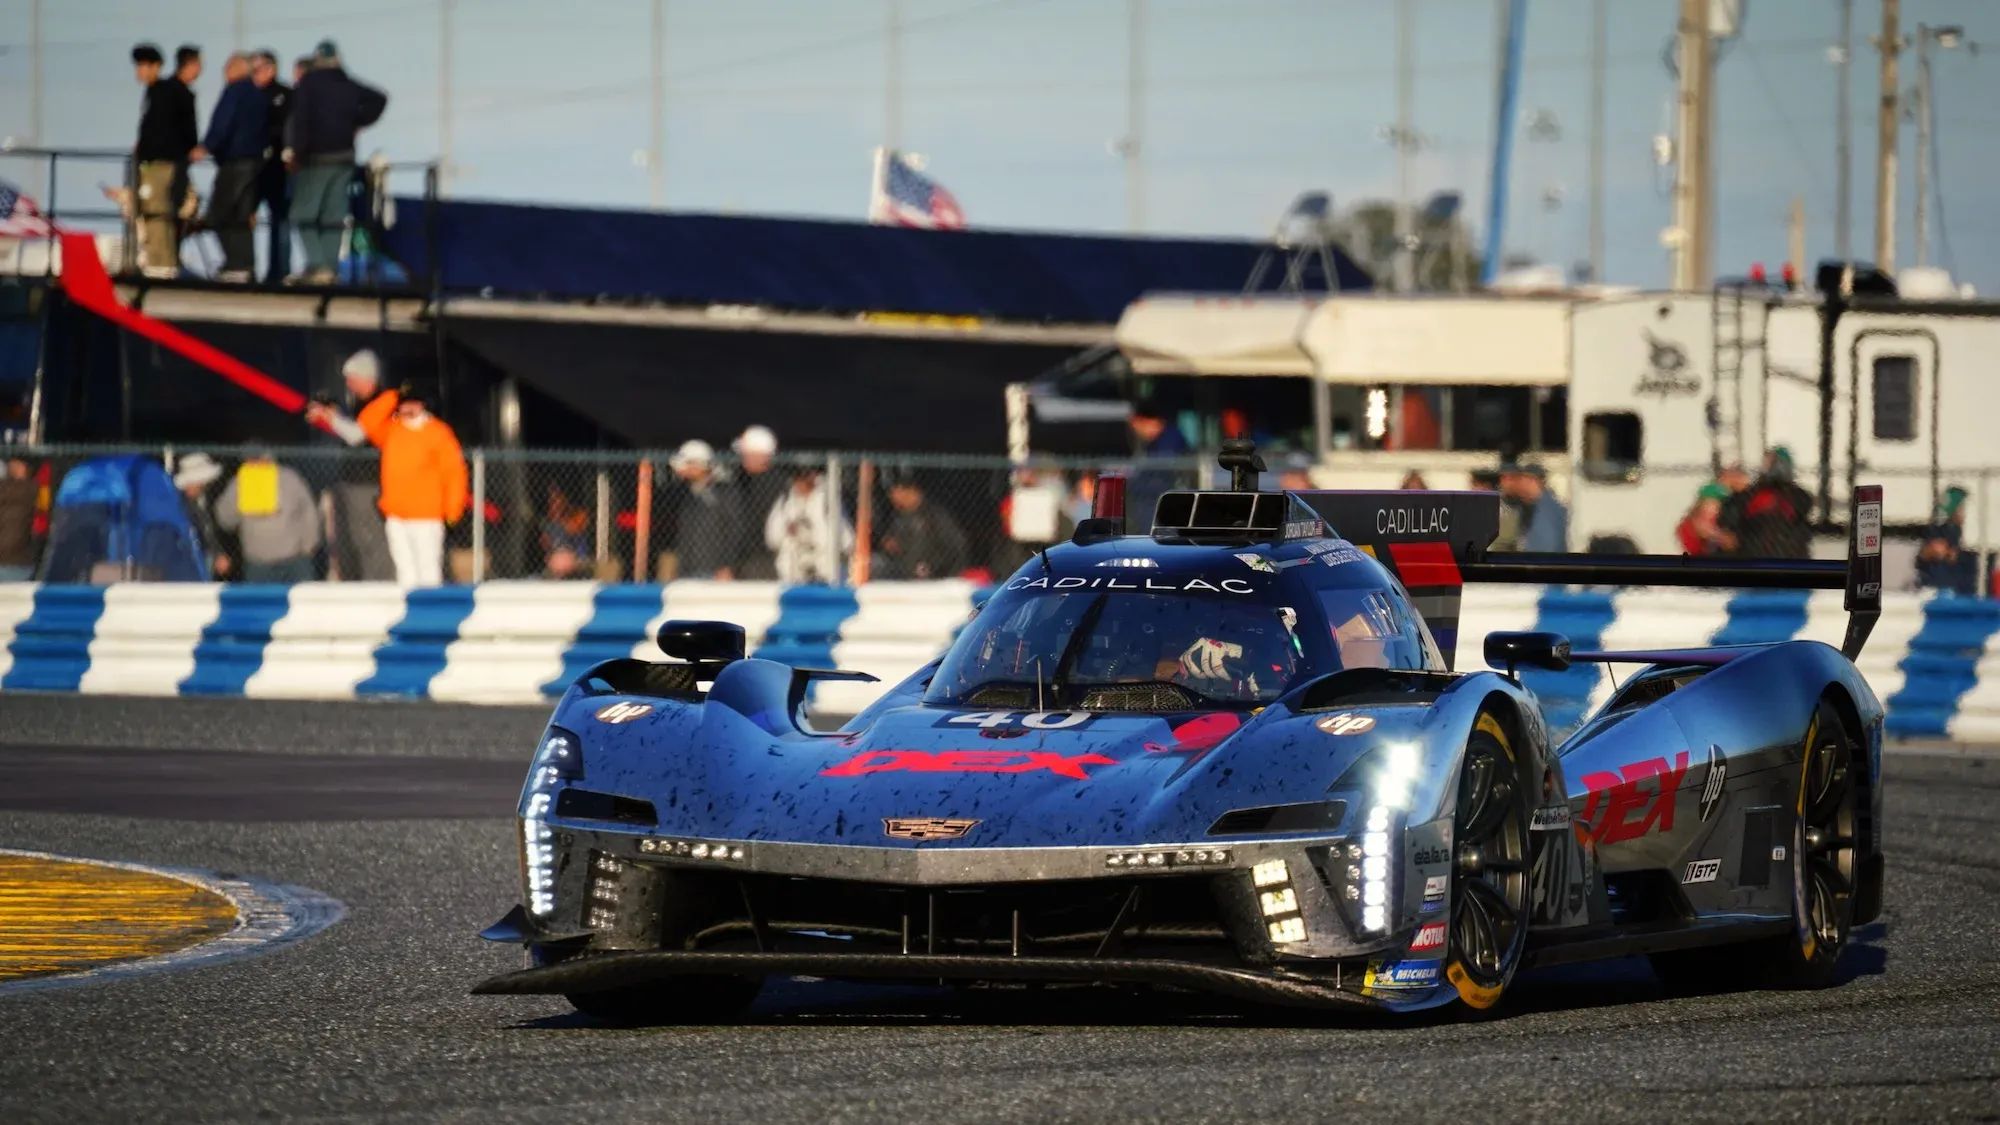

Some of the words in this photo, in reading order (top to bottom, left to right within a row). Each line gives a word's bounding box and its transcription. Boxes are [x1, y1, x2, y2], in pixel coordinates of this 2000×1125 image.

[1376, 507, 1449, 534] CADILLAC
[1859, 509, 1878, 520] HYBRID
[1007, 577, 1253, 594] CADILLAC
[599, 701, 652, 724] hp
[948, 711, 1091, 729] 40
[1320, 713, 1374, 735] hp
[819, 750, 1121, 780] DEX
[1701, 744, 1727, 822] hp
[1579, 751, 1689, 845] DEX
[1695, 863, 1718, 878] GTP
[1412, 926, 1444, 947] MOTUL
[1395, 968, 1437, 980] MICHELIN
